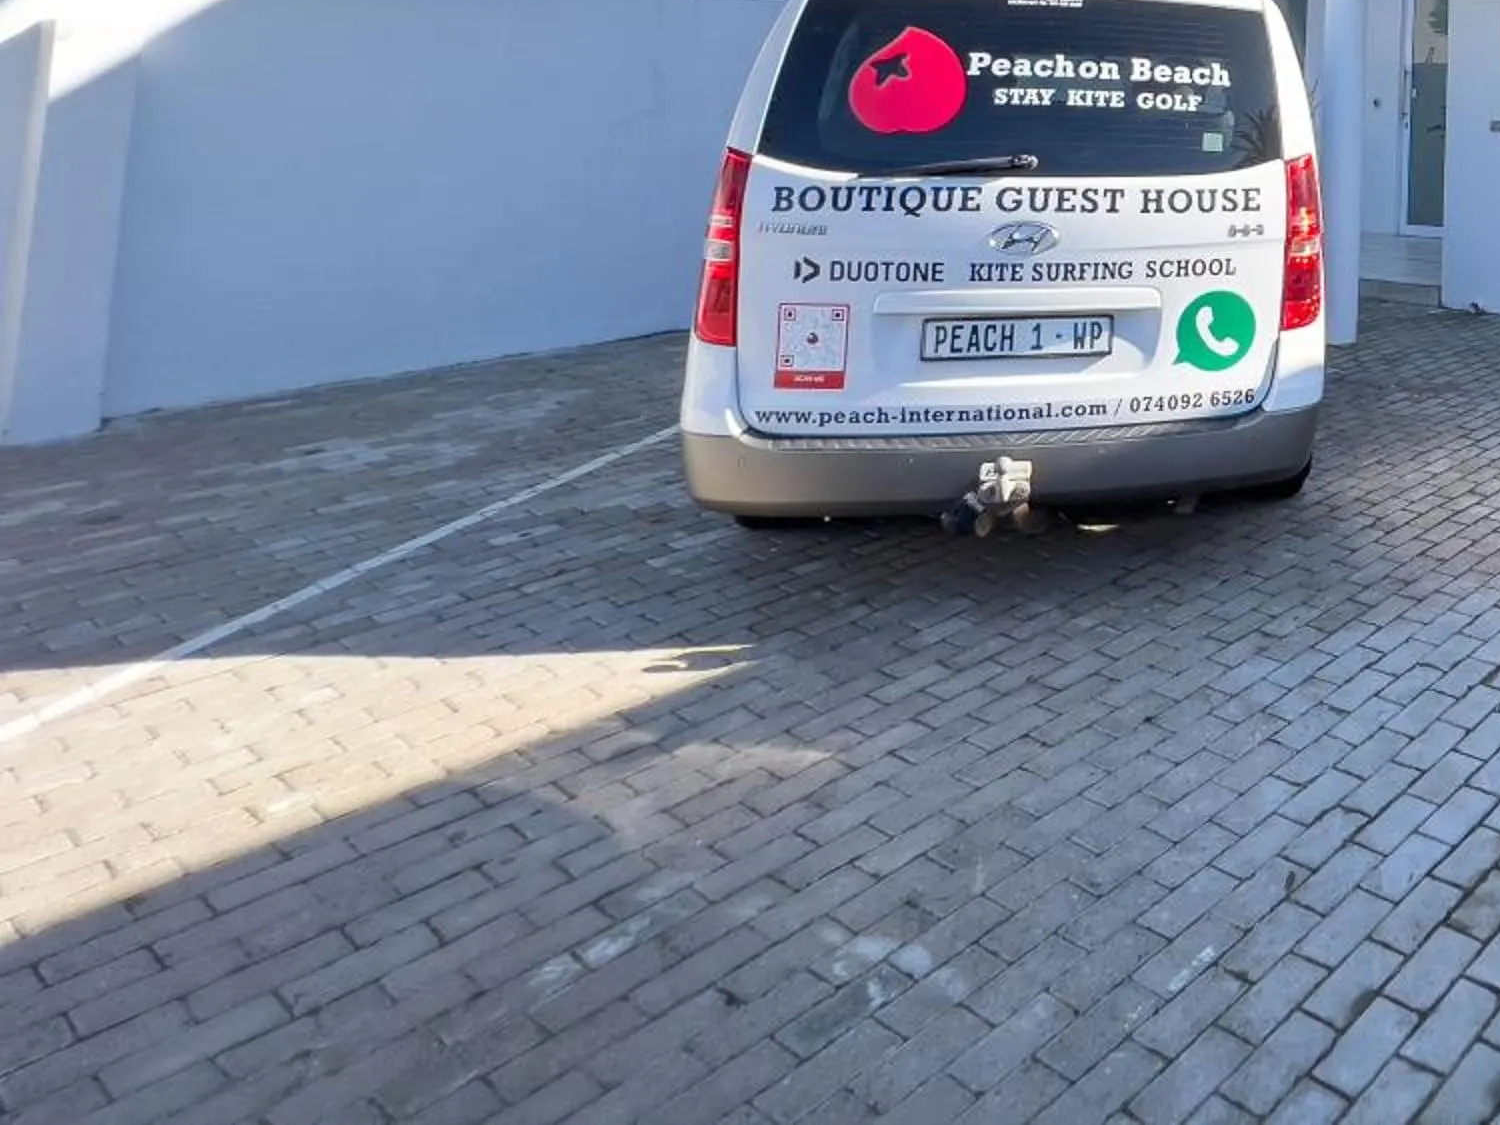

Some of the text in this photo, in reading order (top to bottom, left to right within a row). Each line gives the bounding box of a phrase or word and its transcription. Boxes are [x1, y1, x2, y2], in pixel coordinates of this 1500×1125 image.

[1130, 58, 1231, 87] Beach
[994, 88, 1203, 112] STAY KITE GOLF
[771, 185, 1262, 217] BOUTIQUE GUEST HOUSE
[829, 262, 945, 283] DUOTONE
[969, 257, 1238, 283] KITE SURFING SCHOOL
[934, 321, 1103, 353] PEACH 1 WP
[755, 401, 1108, 427] www.peach-international.com
[1130, 393, 1203, 415] 074092
[1210, 388, 1256, 408] 6526
